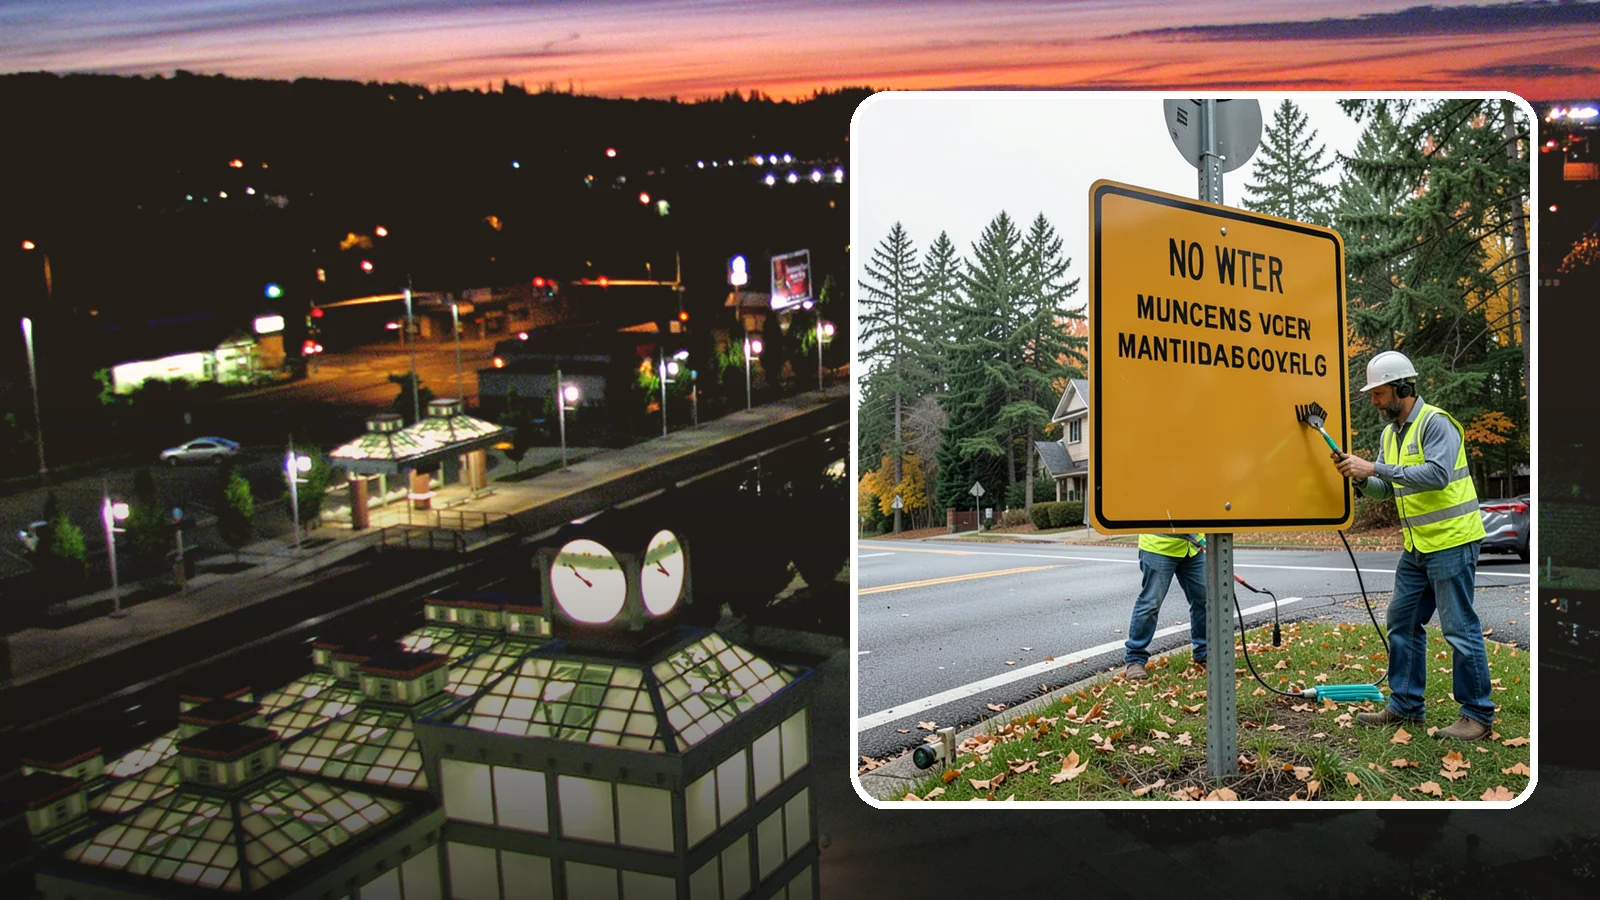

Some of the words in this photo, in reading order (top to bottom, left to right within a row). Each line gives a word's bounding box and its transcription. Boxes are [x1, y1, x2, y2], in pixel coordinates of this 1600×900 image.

[1169, 237, 1204, 281] NO
[1215, 245, 1284, 295] WTER
[1137, 293, 1252, 333] MUNCENS
